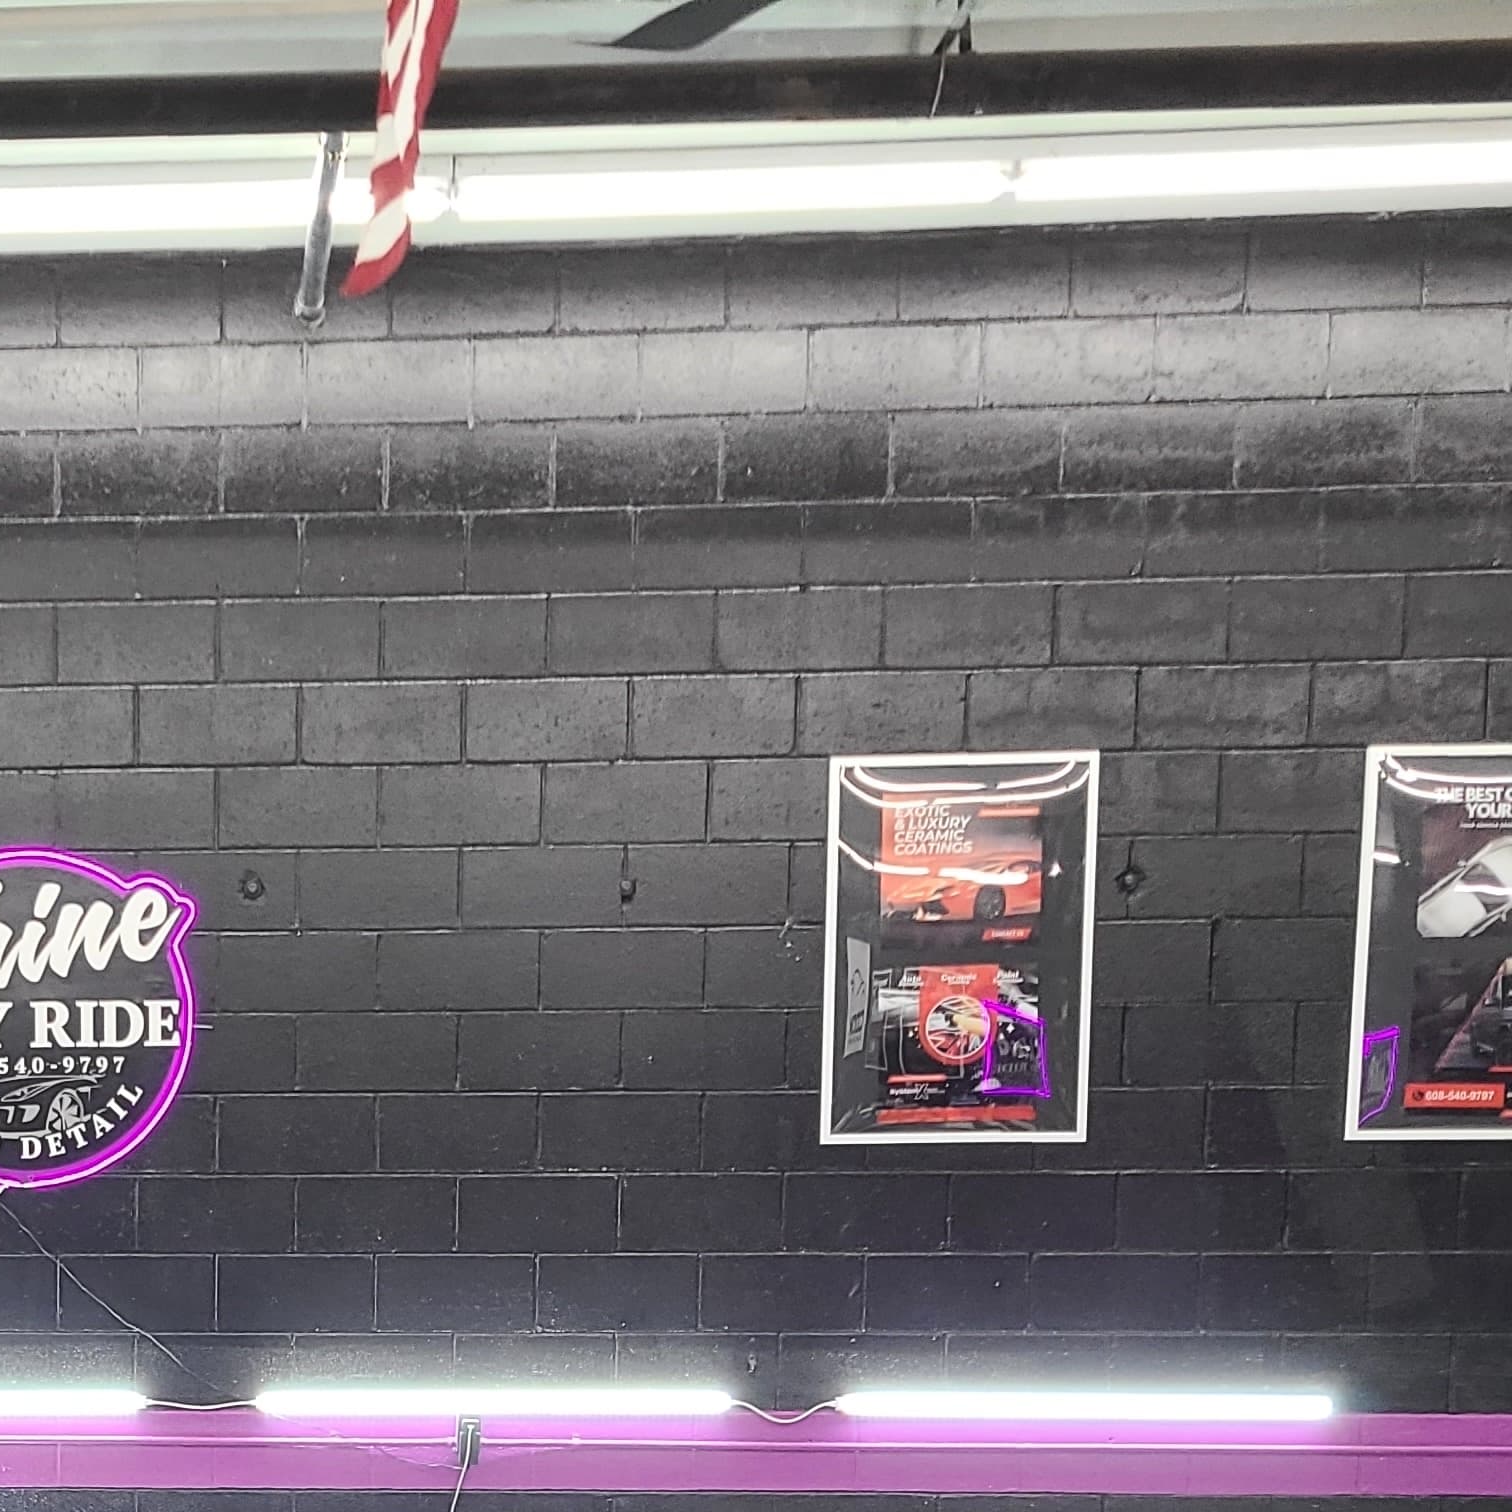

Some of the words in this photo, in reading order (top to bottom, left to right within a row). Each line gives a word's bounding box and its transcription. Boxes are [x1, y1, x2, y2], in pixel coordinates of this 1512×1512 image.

[1466, 785, 1504, 803] BEST
[894, 805, 951, 818] EXOTIC
[908, 815, 971, 831] LUXURY
[894, 829, 965, 843] CERAMIC
[894, 841, 973, 856] COATINGS
[29, 999, 181, 1048] RIDE
[20, 1084, 144, 1160] DETAIL
